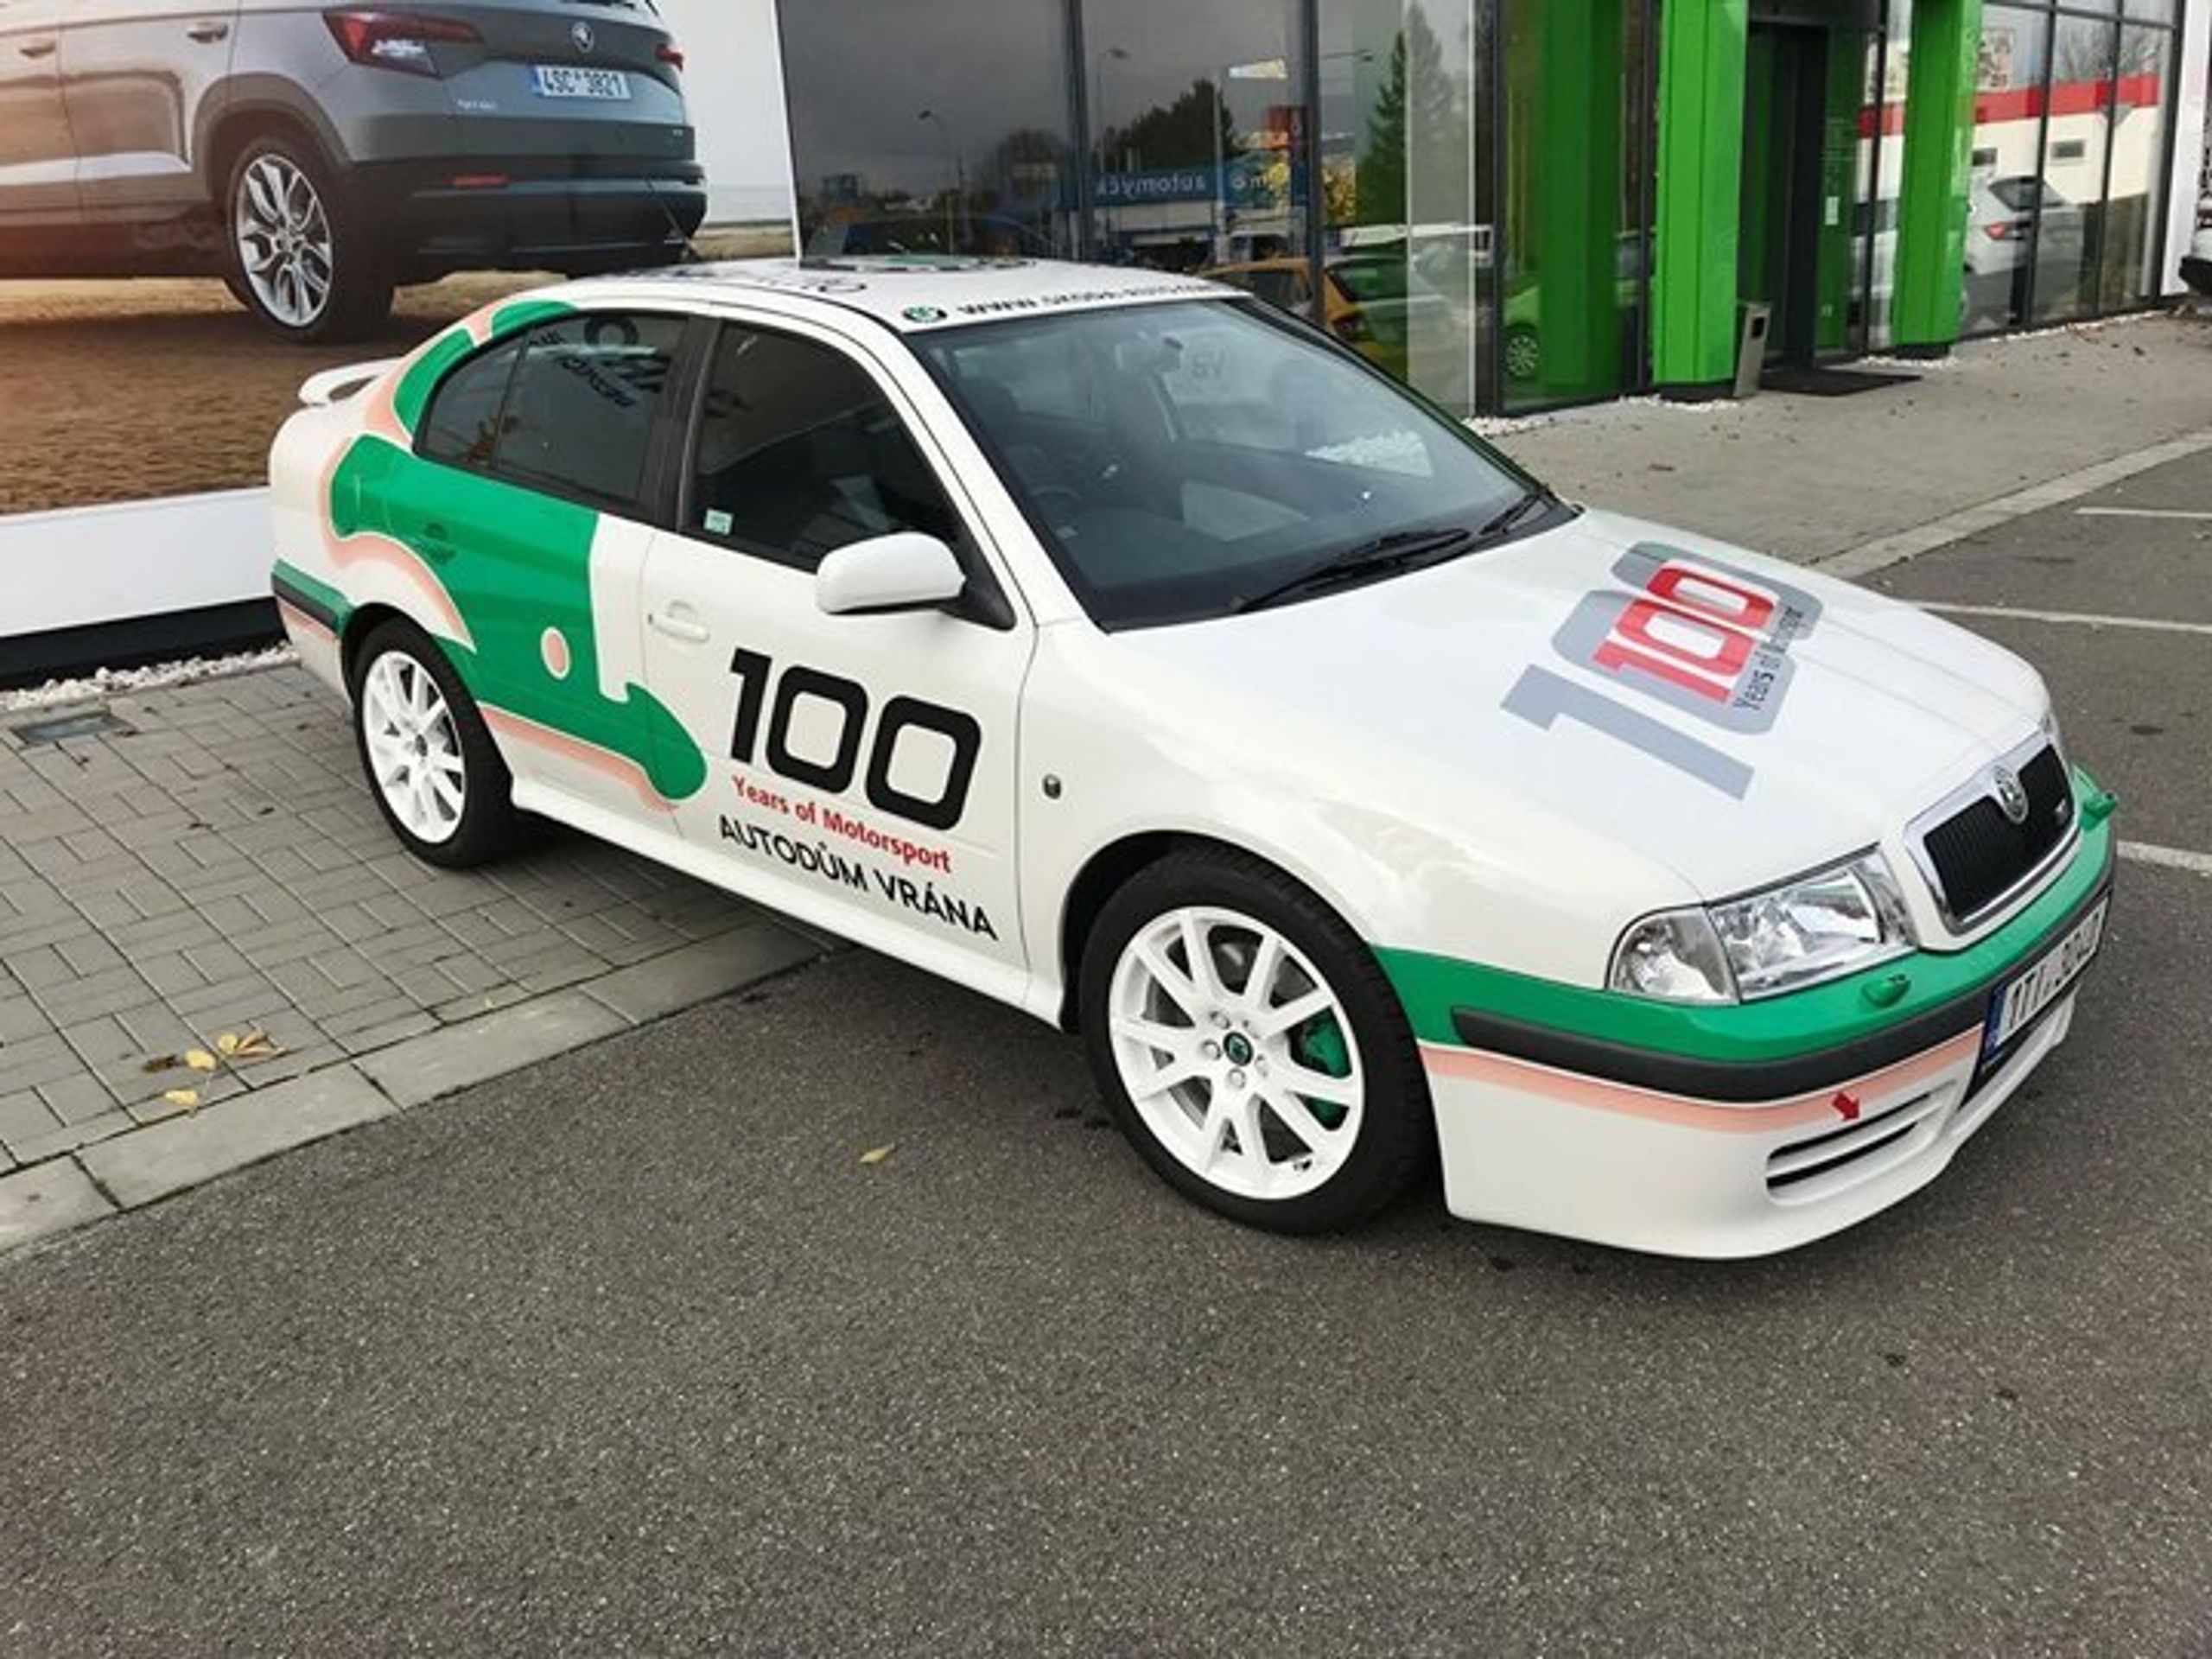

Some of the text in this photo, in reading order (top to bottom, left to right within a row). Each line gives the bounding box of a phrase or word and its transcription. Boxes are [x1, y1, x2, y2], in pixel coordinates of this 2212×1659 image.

[1592, 568, 1775, 704] 100
[729, 647, 982, 831] 100
[719, 814, 999, 941] AUTODŮM VRÁNA
[732, 774, 951, 874] Years of Motorsport
